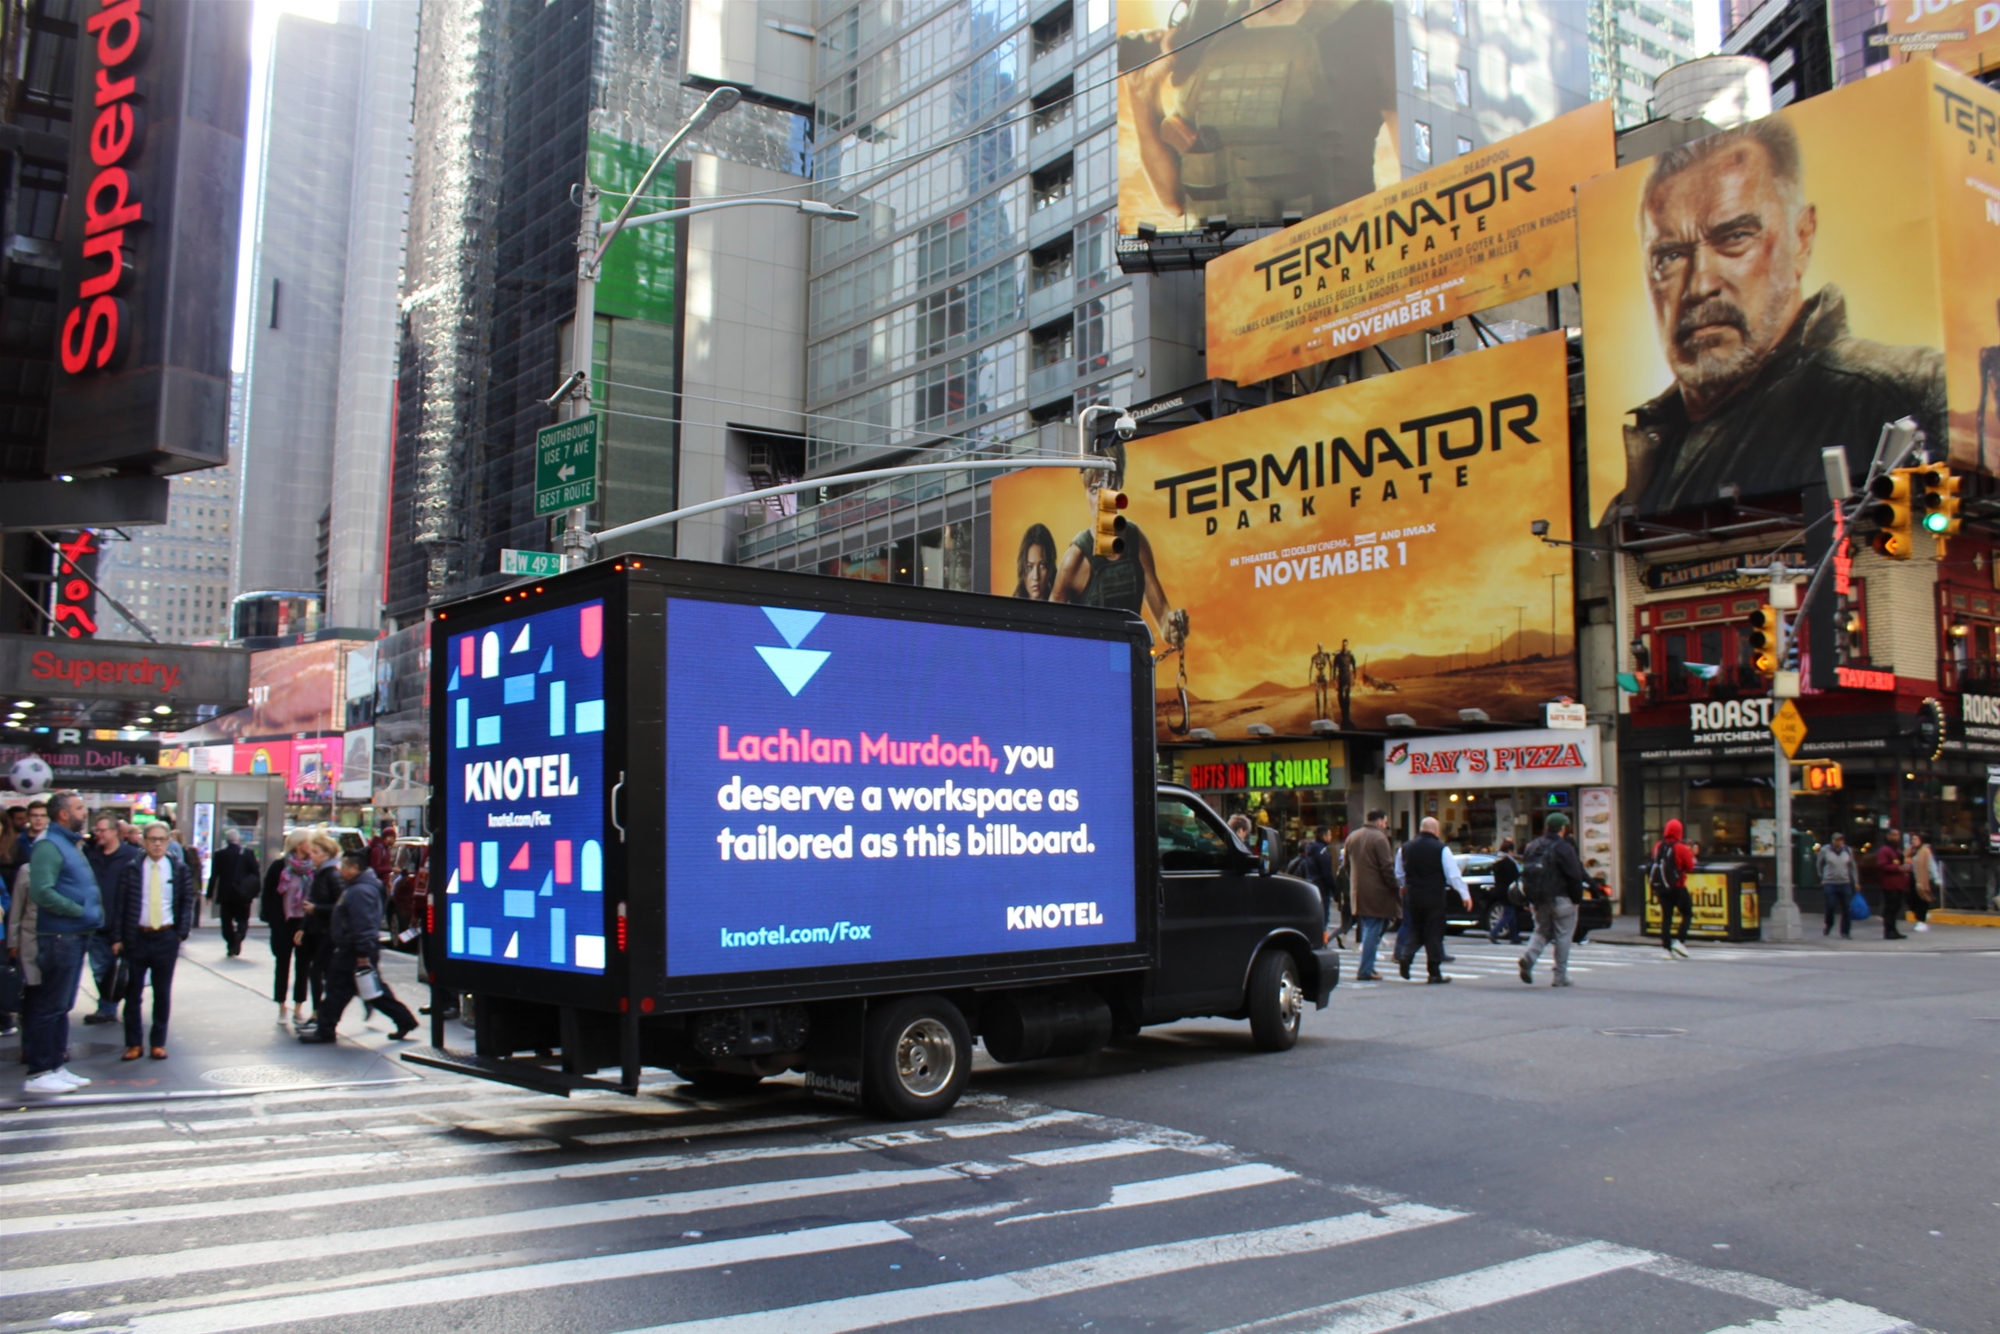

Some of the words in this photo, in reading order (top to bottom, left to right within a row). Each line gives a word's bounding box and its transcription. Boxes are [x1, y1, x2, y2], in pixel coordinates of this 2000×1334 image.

[1934, 82, 2000, 148] TER
[1463, 148, 1511, 175] DEADPOOL
[61, 0, 142, 374] Superd
[1383, 193, 1398, 206] TIM
[1401, 180, 1429, 200] MILLER
[1253, 155, 1537, 292] TERMINATOR
[1289, 230, 1311, 246] JAMES
[1312, 213, 1349, 237] CAMERON
[1293, 256, 1376, 300] DARK
[1401, 215, 1487, 260] FATE
[1468, 252, 1485, 267] TIM
[1488, 239, 1520, 259] MILLER
[1260, 307, 1295, 327] CAMERON
[1303, 295, 1334, 312] CHARLES
[1366, 274, 1385, 291] JOSH
[1387, 259, 1429, 285] FRIEDMAN
[1438, 247, 1463, 265] DAVID
[1465, 235, 1494, 255] GOYER
[1506, 219, 1537, 241] JUSTIN
[1308, 308, 1332, 322] GOYER
[1341, 294, 1367, 312] JUSTIN
[1369, 283, 1399, 302] RHODES
[1408, 272, 1430, 288] BILLY
[1432, 264, 1448, 280] RAY
[1332, 298, 1433, 348] NOVEMBER
[1436, 292, 1446, 313] 1
[540, 420, 595, 449] SOUTHBOUND
[544, 447, 561, 465] USE
[564, 445, 570, 459] 7
[573, 439, 590, 457] AVE
[1154, 392, 1541, 519] TERMINATOR
[539, 489, 560, 508] BEST
[563, 482, 592, 503] ROUTE
[1206, 495, 1316, 536] DARK
[1350, 464, 1468, 507] FATE
[1230, 558, 1239, 567] IN
[1380, 529, 1401, 542] AND
[1403, 523, 1436, 538] IMAX
[517, 554, 529, 572] W
[531, 556, 548, 573] 49
[1255, 545, 1389, 588] NOVEMBER
[1397, 541, 1407, 566] 1
[1661, 556, 1740, 586] PLAYWRIGHT
[1836, 667, 1896, 691] TAVERN
[1690, 697, 1773, 731] ROAST
[1962, 693, 2000, 726] ROAS
[718, 725, 852, 764] Lachlan
[860, 731, 999, 773] Murdoch,
[1003, 744, 1054, 775] you
[1702, 730, 1762, 744] KITCHEN
[1803, 742, 1845, 751] DELICIOUS
[85, 750, 131, 767] Dolls
[1190, 763, 1225, 789] GIFTS
[1228, 763, 1246, 788] ON
[1247, 761, 1272, 787] THE
[1274, 758, 1329, 788] SQUARE
[1409, 748, 1489, 775] RAY'S
[1494, 743, 1586, 771] PIZZA
[465, 753, 579, 803] KNOTEL
[717, 776, 854, 812] deserve
[861, 788, 882, 812] a
[888, 779, 1043, 818] workspace
[1048, 787, 1079, 812] as
[488, 811, 551, 828] knotel.com/Fox
[717, 825, 853, 861] tailored
[861, 833, 898, 859] as
[903, 824, 961, 857] this
[967, 823, 1096, 856] billboard.
[1006, 902, 1104, 931] KNOTEL
[721, 921, 871, 948] knotel.com/Fox
[806, 1070, 861, 1095] Rockport
